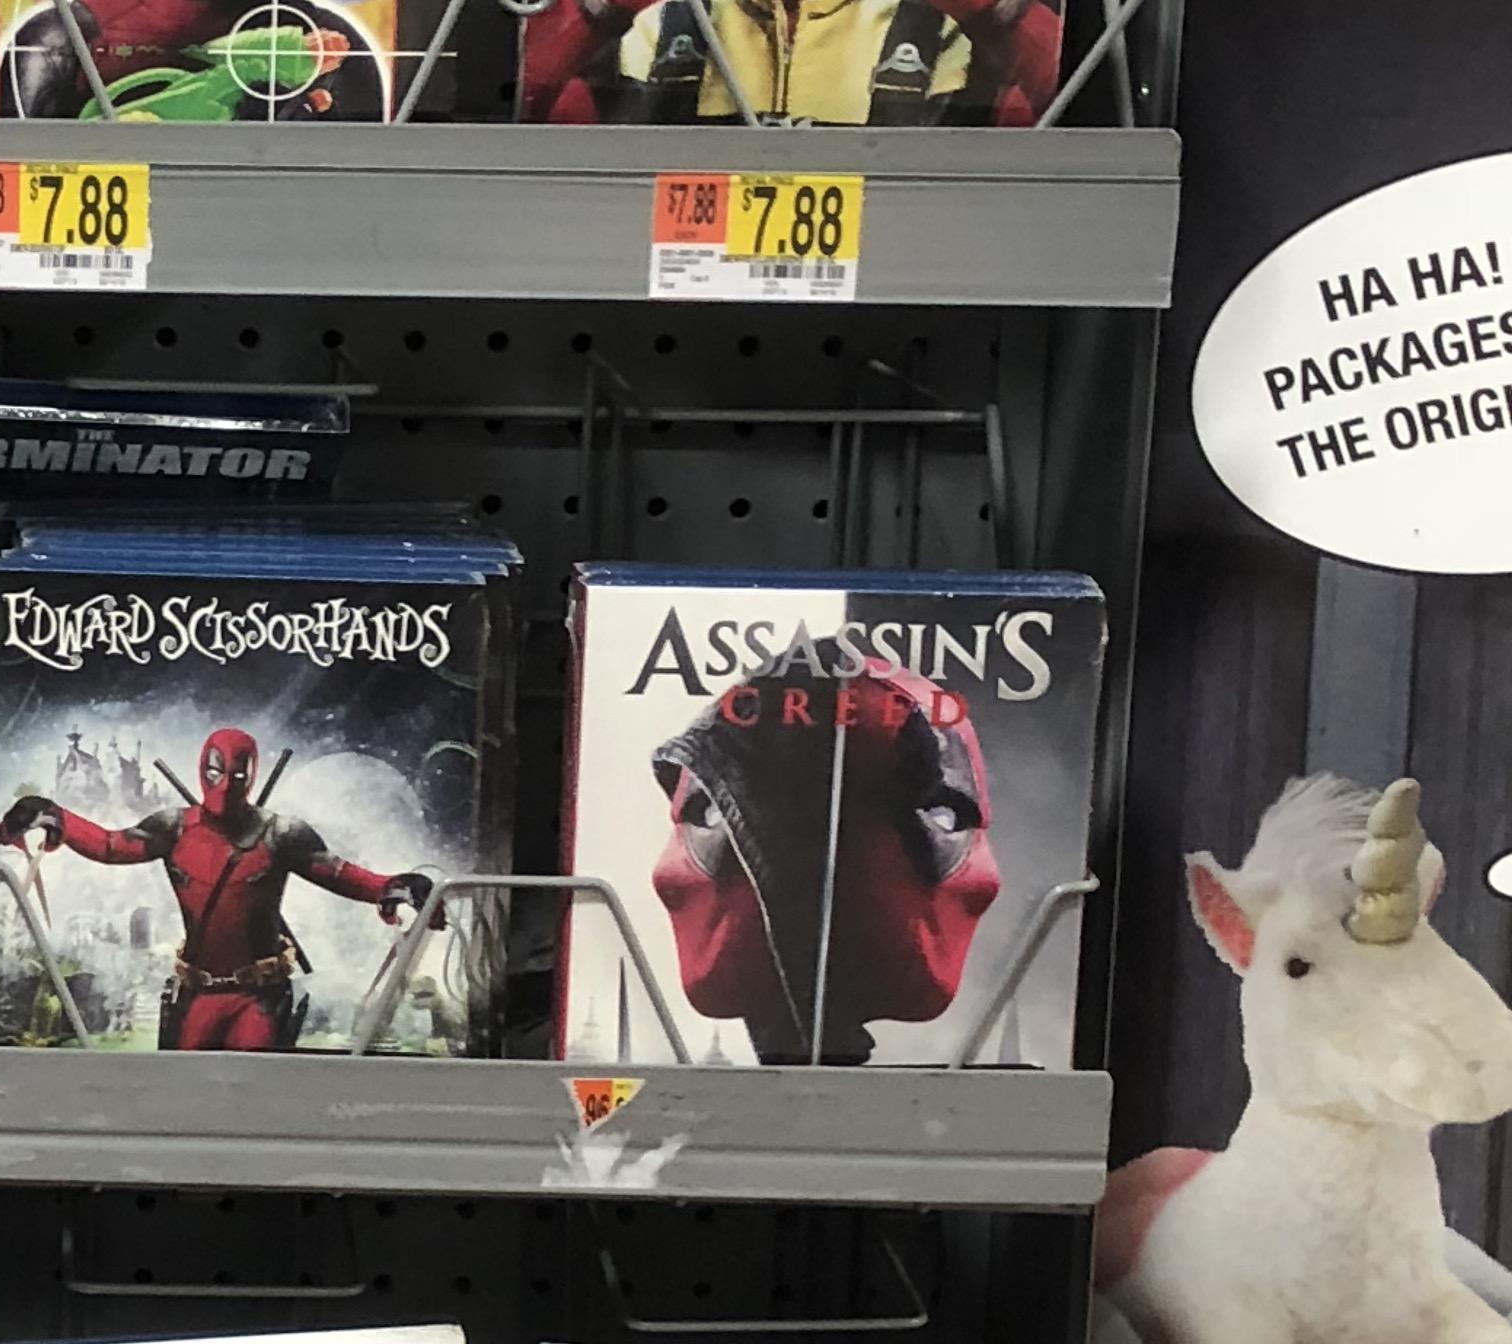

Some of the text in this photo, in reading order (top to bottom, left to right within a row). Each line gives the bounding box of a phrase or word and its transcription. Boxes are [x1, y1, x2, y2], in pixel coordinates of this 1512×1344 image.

[29, 175, 127, 245] $7.88
[668, 183, 718, 225] $7.88
[741, 186, 842, 256] $7.88
[1318, 241, 1502, 321] HA HA!
[1264, 310, 1512, 411] PACKAGES
[1276, 417, 1375, 477] THE
[2, 587, 452, 670] EDWARD SCISSORHANDS
[625, 606, 1054, 702] ASSASSIN'S
[719, 686, 971, 729] CREED
